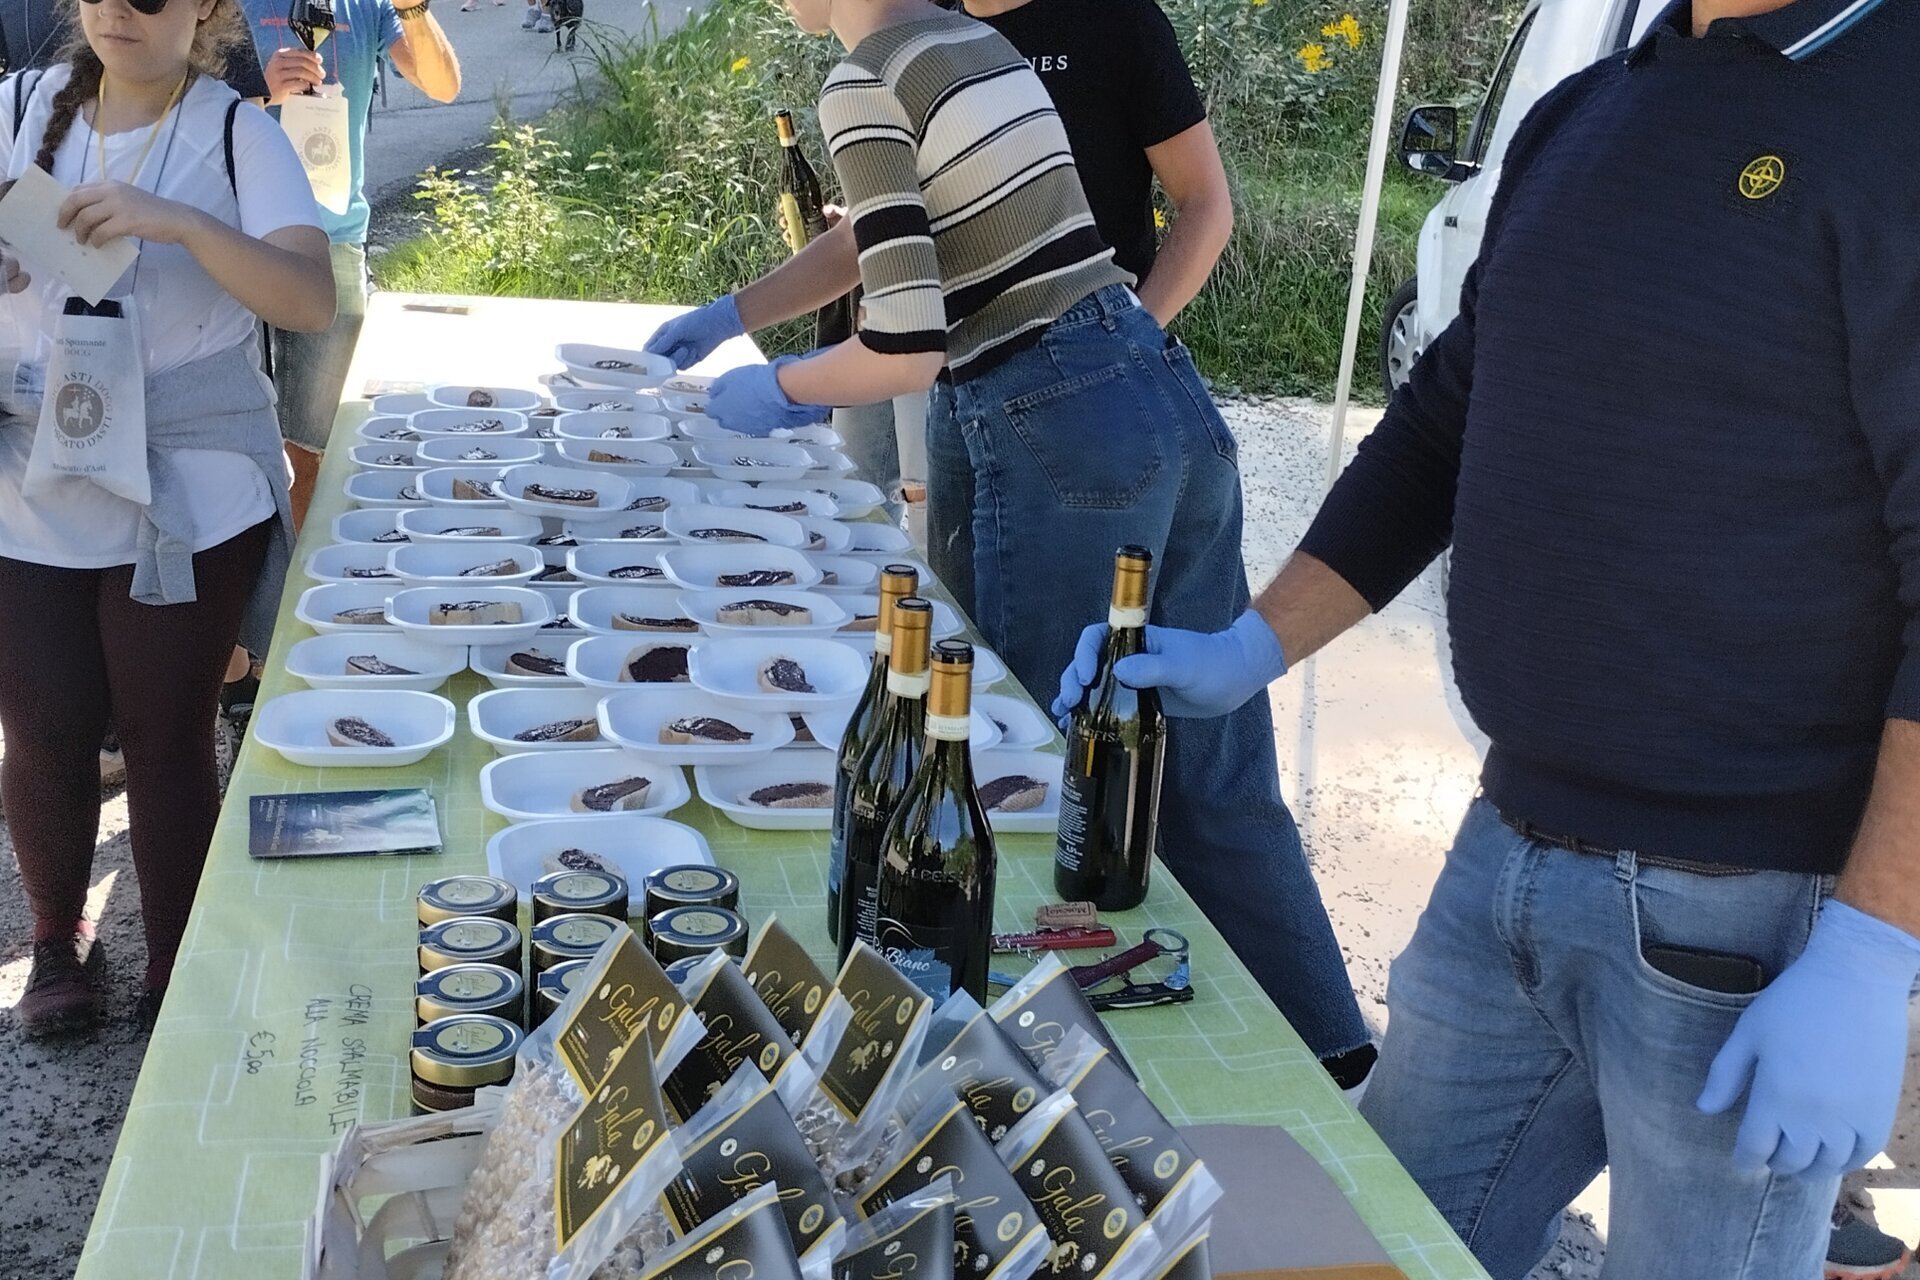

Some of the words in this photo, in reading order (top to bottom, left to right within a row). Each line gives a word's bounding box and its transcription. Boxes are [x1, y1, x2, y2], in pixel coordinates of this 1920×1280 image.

[303, 998, 334, 1027] ALLA
[338, 983, 373, 1028] CREMA
[695, 1013, 761, 1073] Gala
[949, 1058, 1015, 1111] Gala
[594, 1085, 645, 1148] Gala
[1030, 1166, 1106, 1235] Gala
